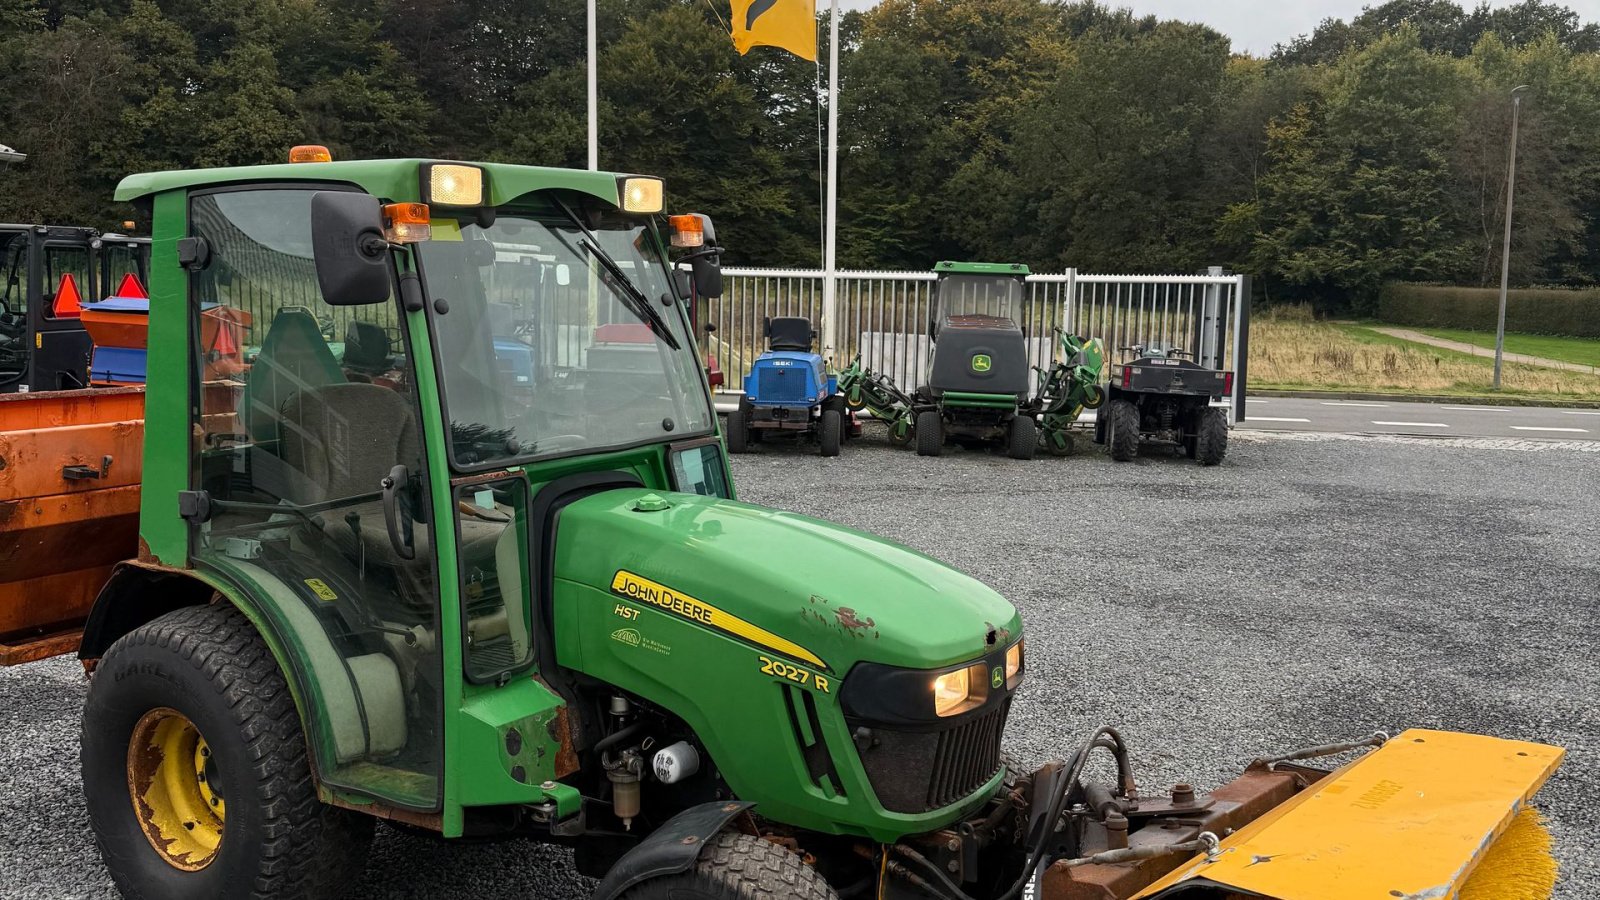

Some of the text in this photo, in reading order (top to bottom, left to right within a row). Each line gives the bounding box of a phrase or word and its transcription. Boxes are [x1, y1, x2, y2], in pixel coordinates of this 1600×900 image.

[614, 604, 641, 621] HST
[619, 578, 713, 623] JOHN DEERE
[759, 656, 829, 693] 2027 R
